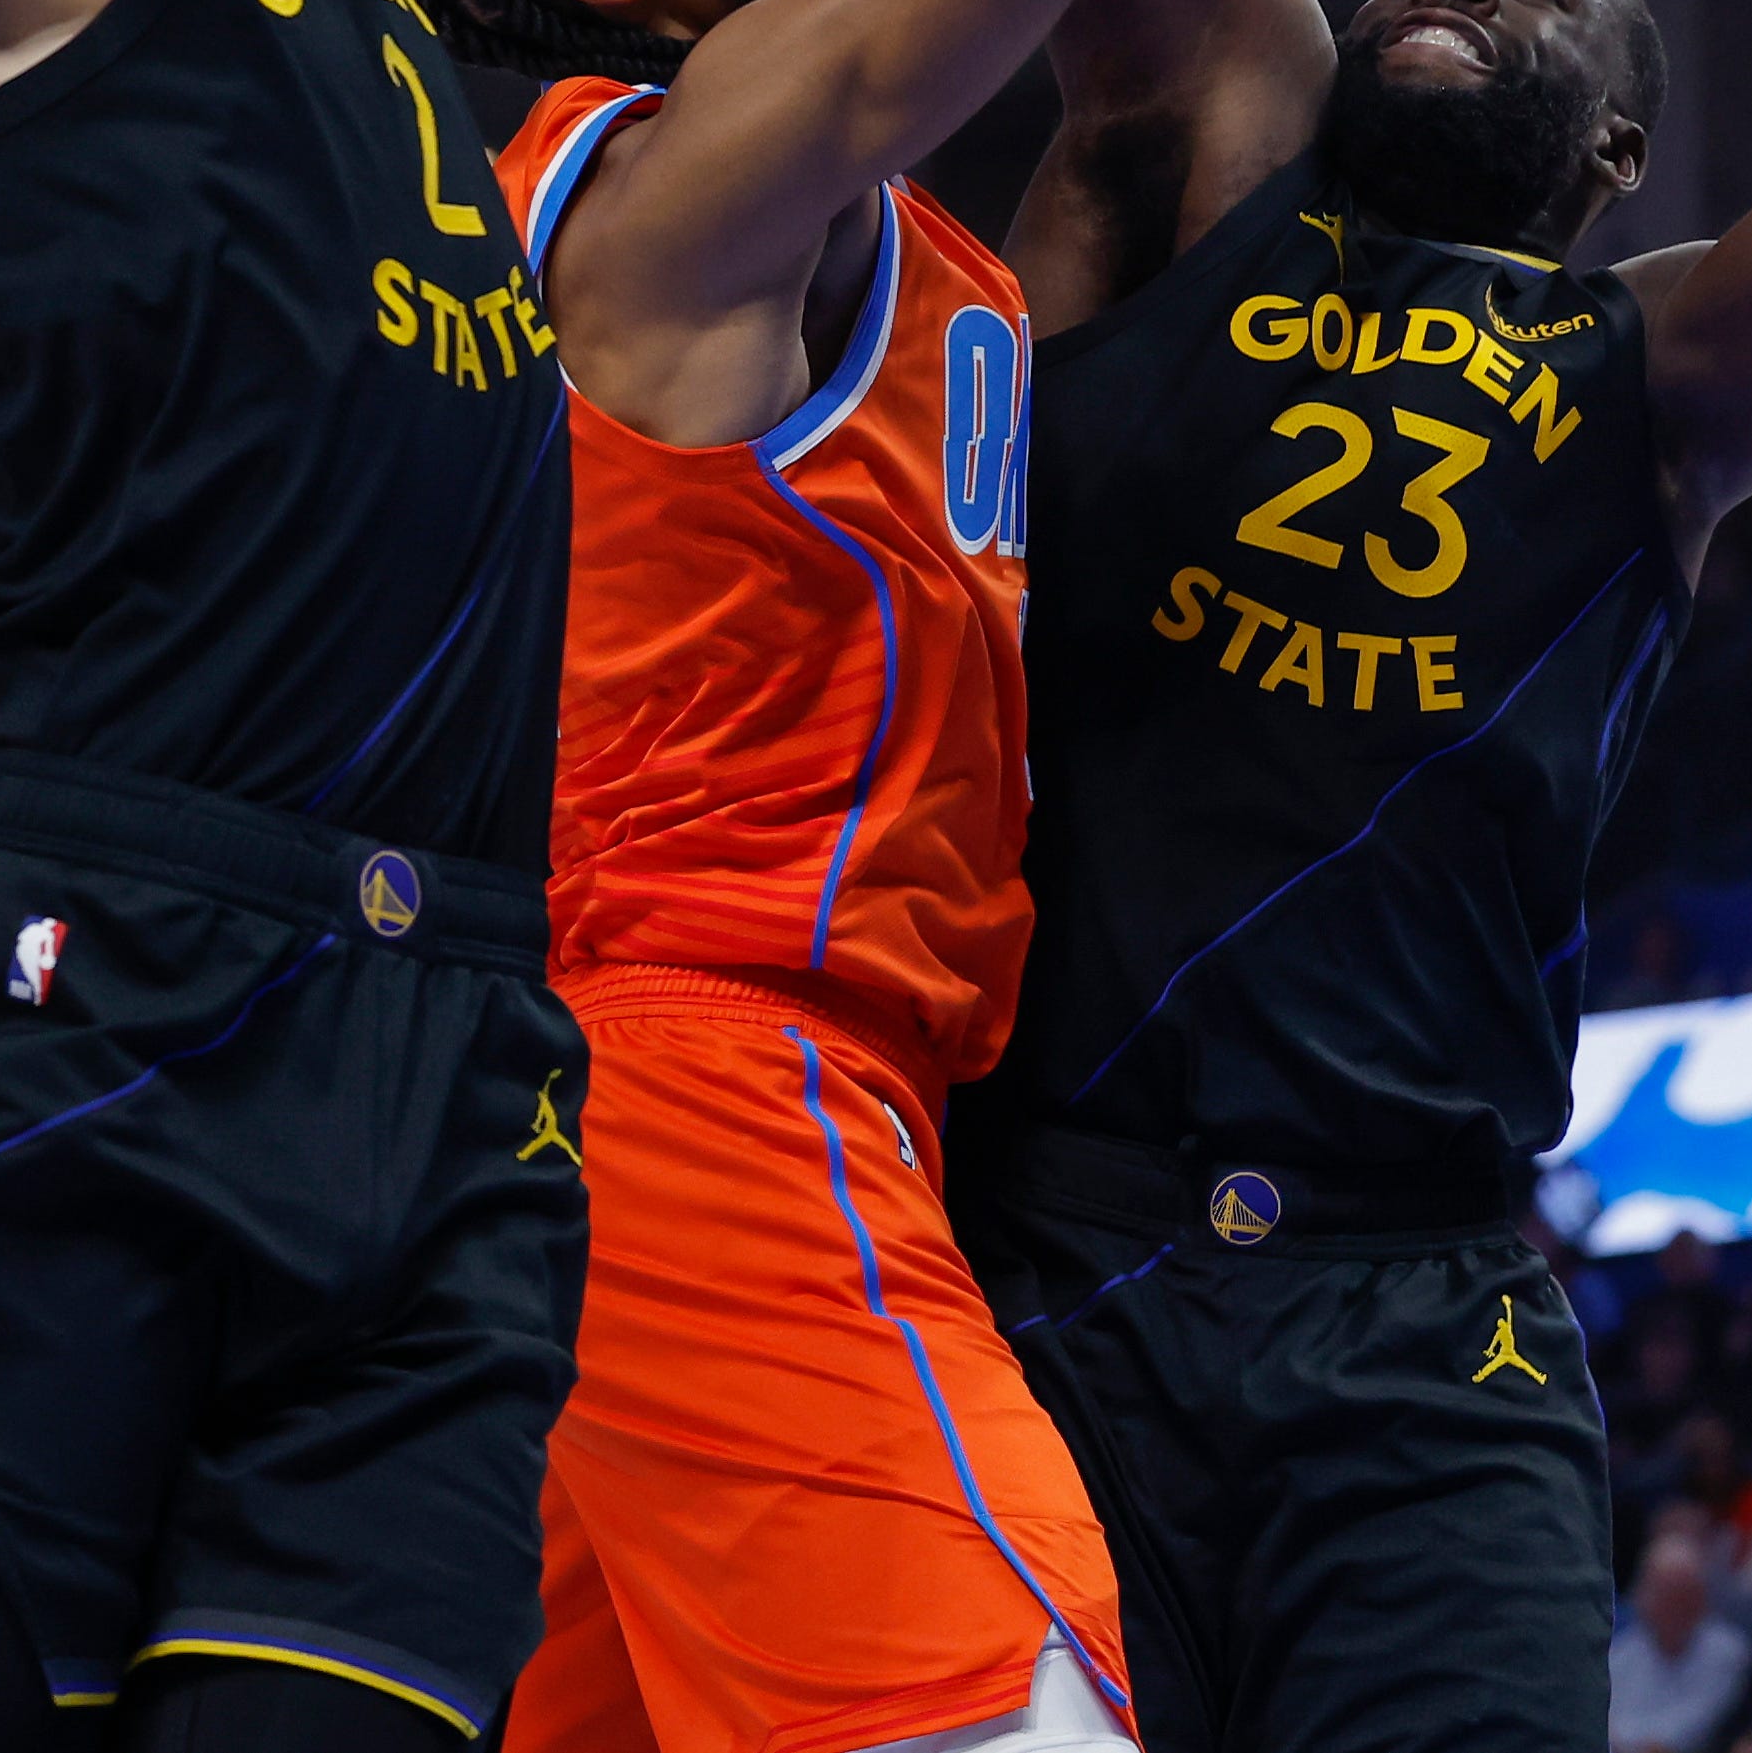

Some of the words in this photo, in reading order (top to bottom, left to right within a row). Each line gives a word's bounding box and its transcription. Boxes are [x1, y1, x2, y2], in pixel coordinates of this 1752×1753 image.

[383, 33, 487, 237] 2
[373, 258, 557, 392] STATE
[1229, 293, 1583, 464] GOLDEN
[1236, 401, 1491, 598] 23
[1150, 566, 1464, 713] STATE
